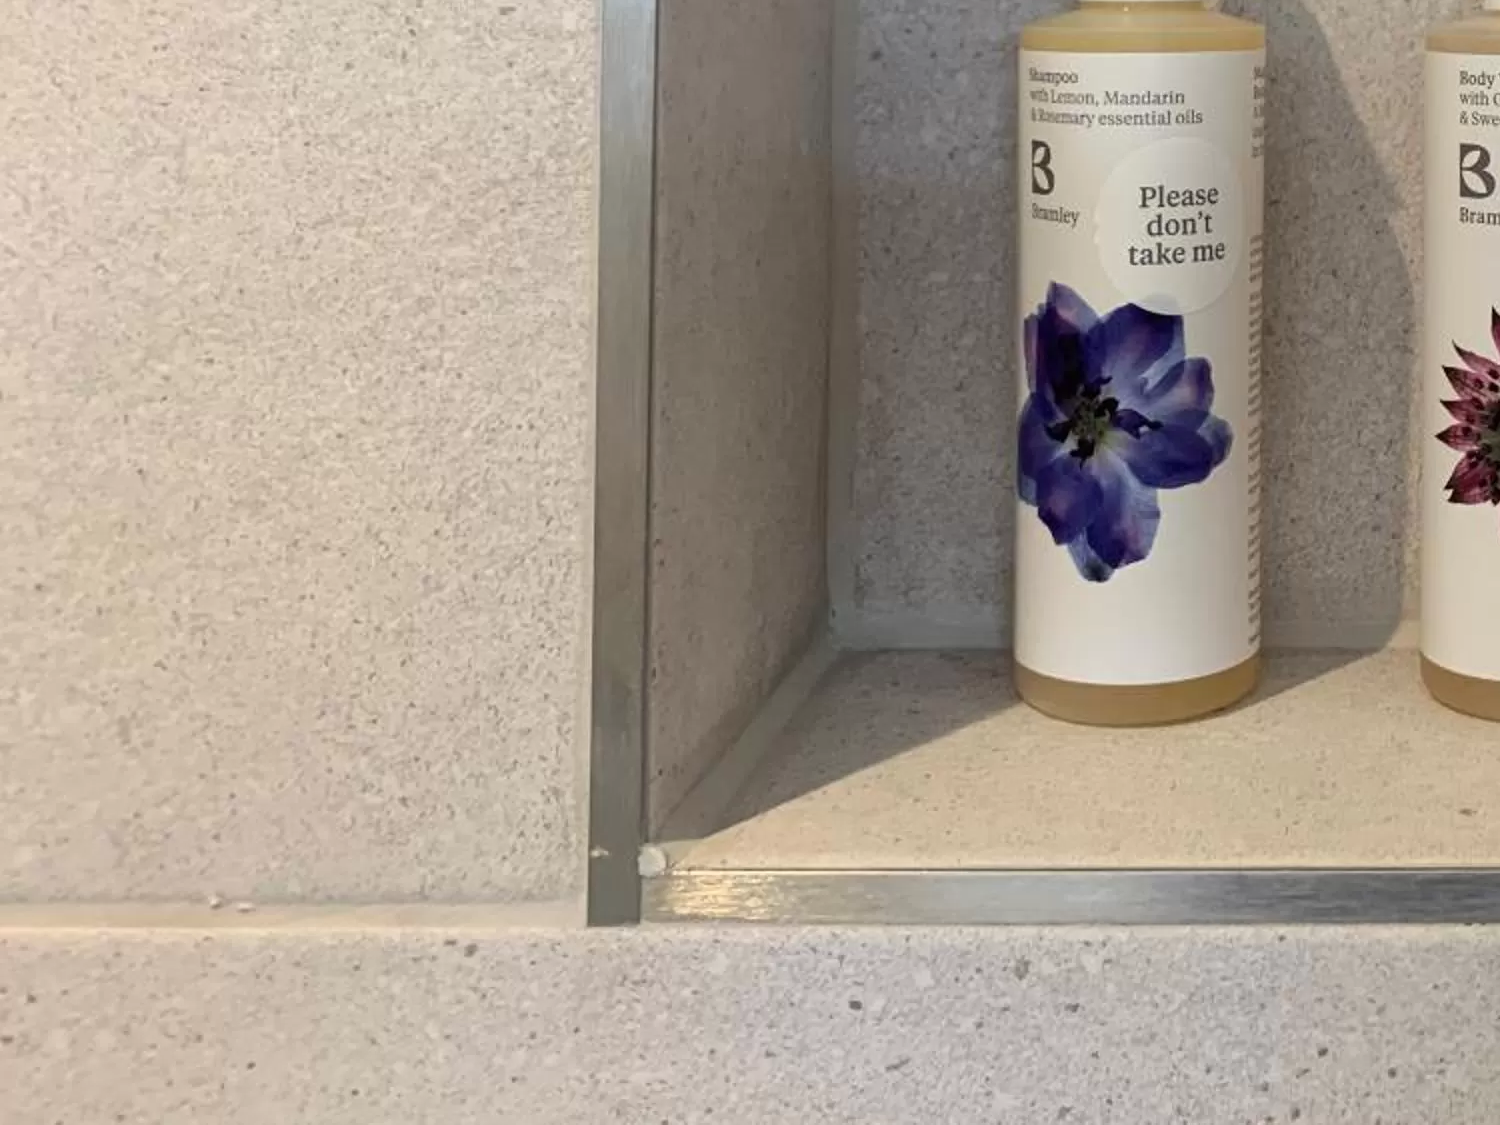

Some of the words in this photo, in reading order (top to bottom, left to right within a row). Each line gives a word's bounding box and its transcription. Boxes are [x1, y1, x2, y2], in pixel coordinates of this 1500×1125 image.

[1029, 67, 1079, 87] Shampoo
[1459, 70, 1496, 89] Body
[1029, 88, 1049, 103] with
[1051, 89, 1099, 107] Lemon,
[1104, 90, 1185, 105] Mandarin
[1459, 90, 1489, 106] with
[1038, 108, 1093, 128] Rosemary
[1099, 109, 1171, 126] essential
[1176, 108, 1203, 124] oils
[1459, 110, 1468, 125] &
[1138, 185, 1219, 209] Please
[1031, 202, 1080, 229] Bramley
[1147, 211, 1213, 237] don't
[1128, 243, 1185, 266] take
[1193, 242, 1225, 263] me
